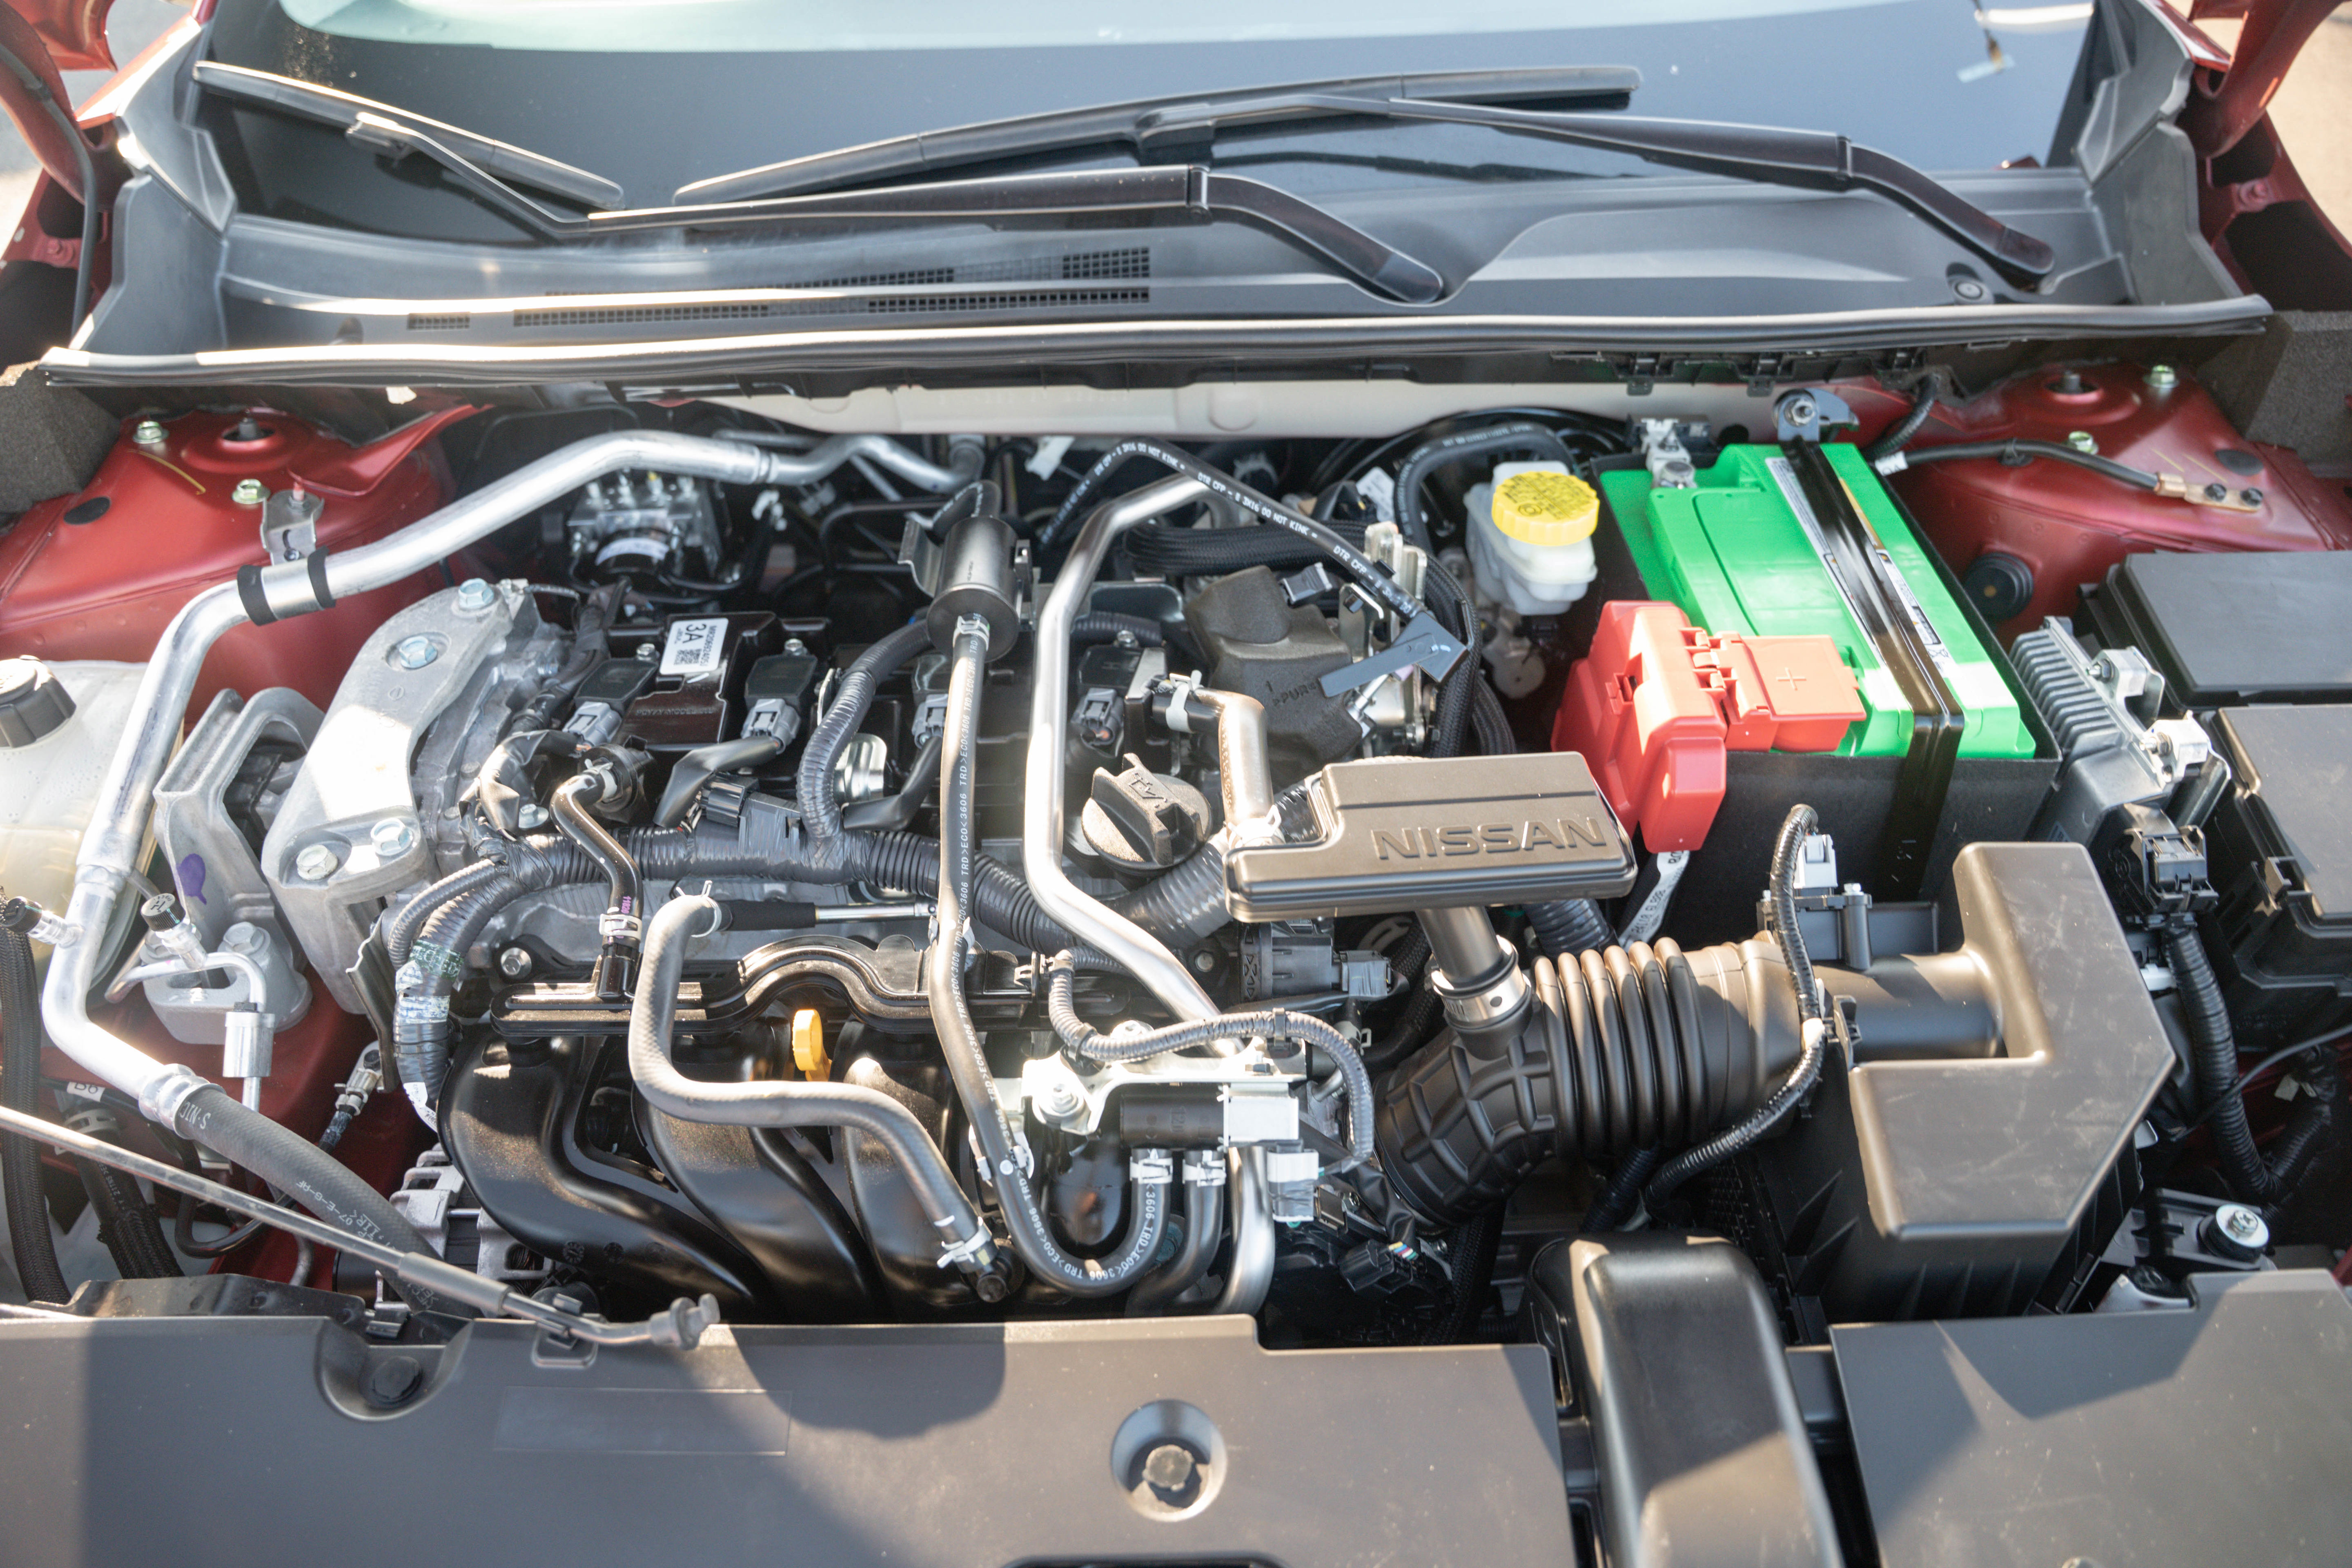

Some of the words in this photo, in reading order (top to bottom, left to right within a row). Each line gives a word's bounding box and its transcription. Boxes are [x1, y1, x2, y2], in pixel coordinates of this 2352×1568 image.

[1148, 445, 1161, 458] NOT
[1162, 452, 1179, 468] KINK
[1198, 472, 1212, 486] DTR
[1273, 512, 1288, 526] NOT
[1289, 519, 1310, 536] KINK
[1333, 544, 1350, 562] DTR
[682, 624, 707, 644] 3A
[1370, 817, 1607, 860] NISSAN
[621, 895, 632, 914] 11820
